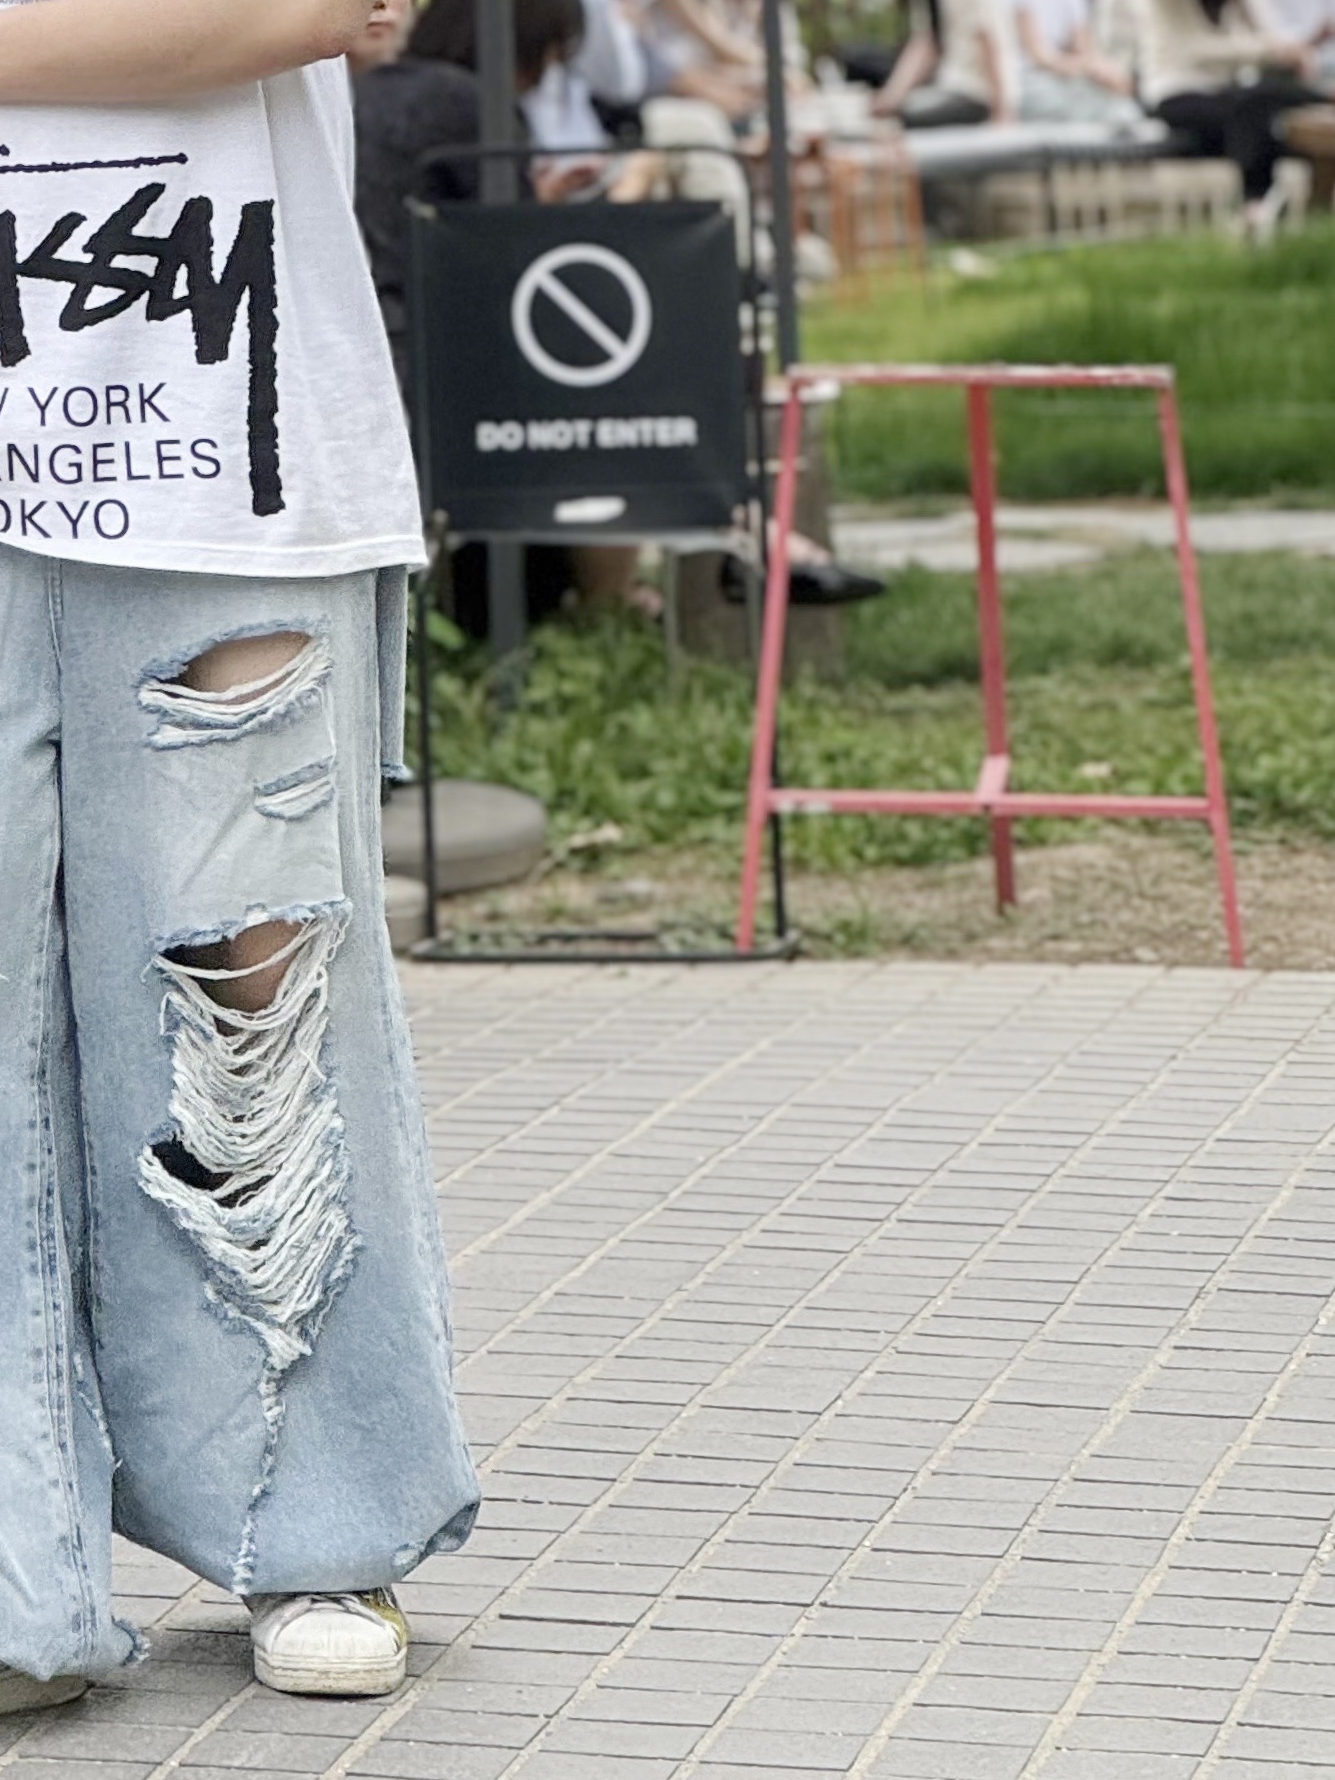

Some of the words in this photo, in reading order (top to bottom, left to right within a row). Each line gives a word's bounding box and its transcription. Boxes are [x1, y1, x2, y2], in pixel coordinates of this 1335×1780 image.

[27, 383, 171, 427] YORK
[476, 420, 525, 451] DO
[526, 419, 593, 450] NOT
[595, 416, 698, 448] ENTER
